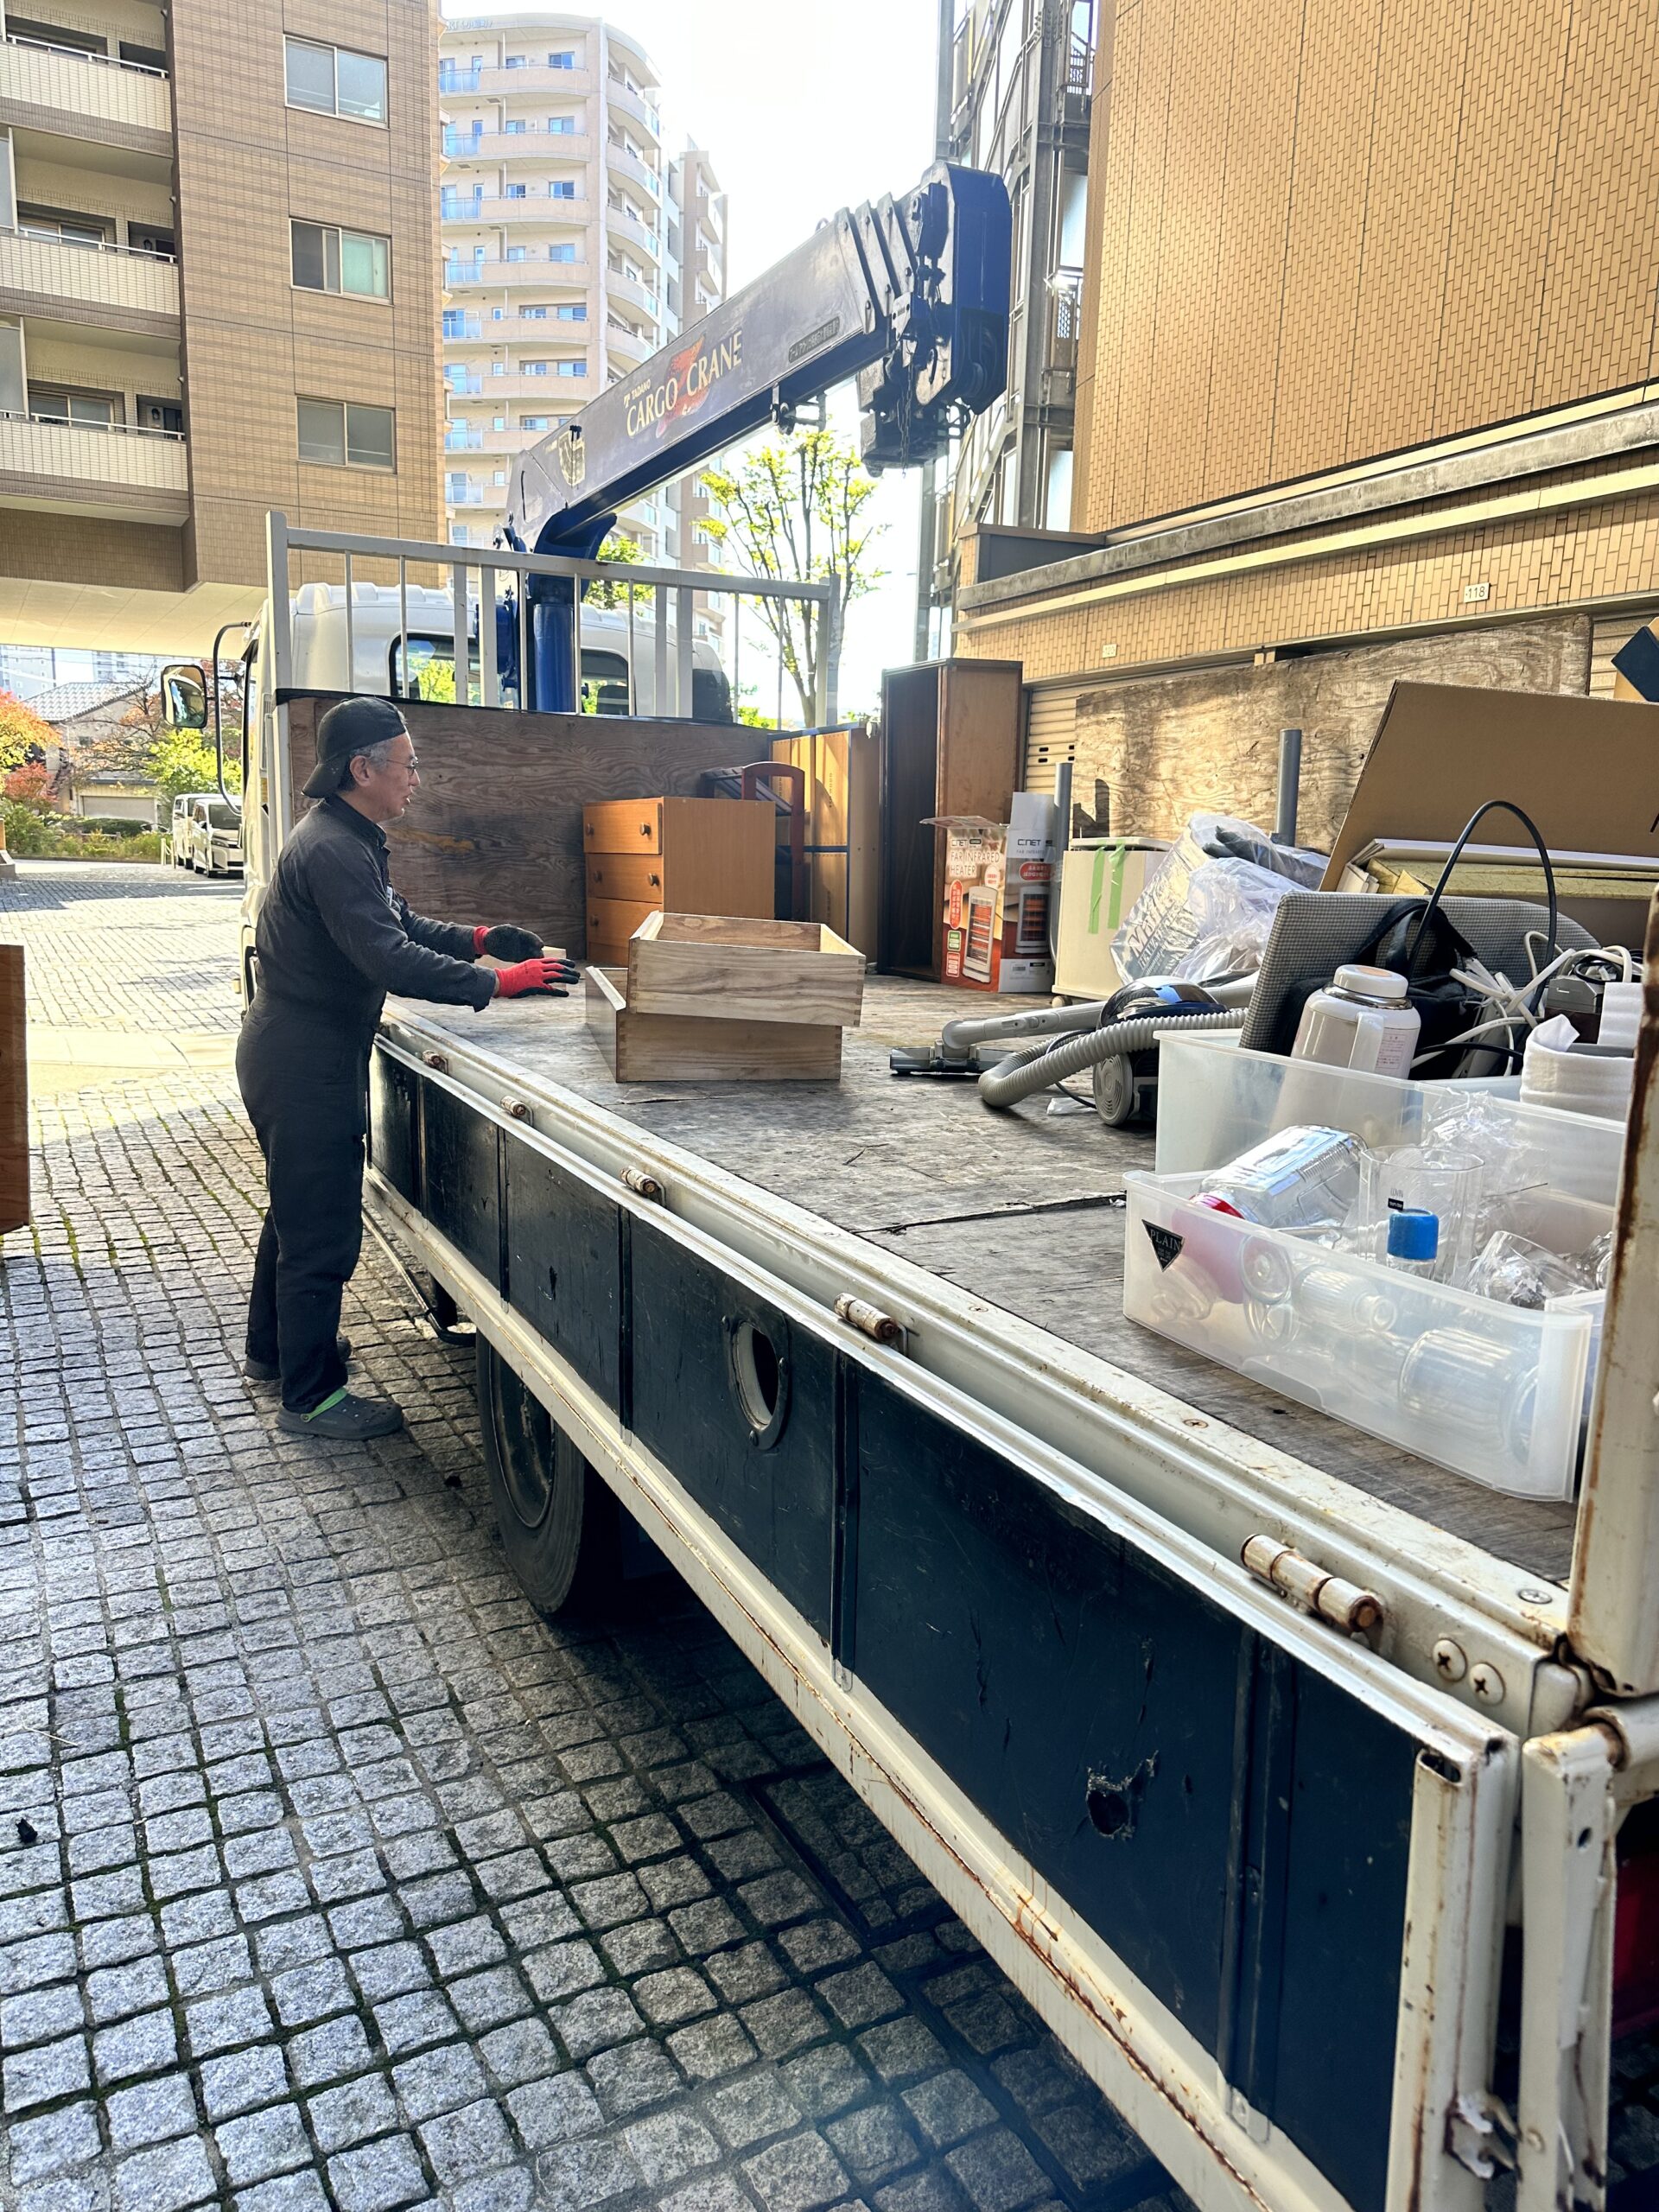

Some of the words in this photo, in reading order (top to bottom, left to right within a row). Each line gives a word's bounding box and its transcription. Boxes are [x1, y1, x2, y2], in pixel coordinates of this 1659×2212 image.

[626, 377, 678, 436] CARGO
[686, 330, 742, 397] CRANE
[631, 378, 652, 400] TADANO
[950, 850, 963, 862] FAR
[965, 851, 1001, 863] INFRARED
[950, 865, 976, 876] HEATER
[1150, 1229, 1181, 1252] PLAIN
